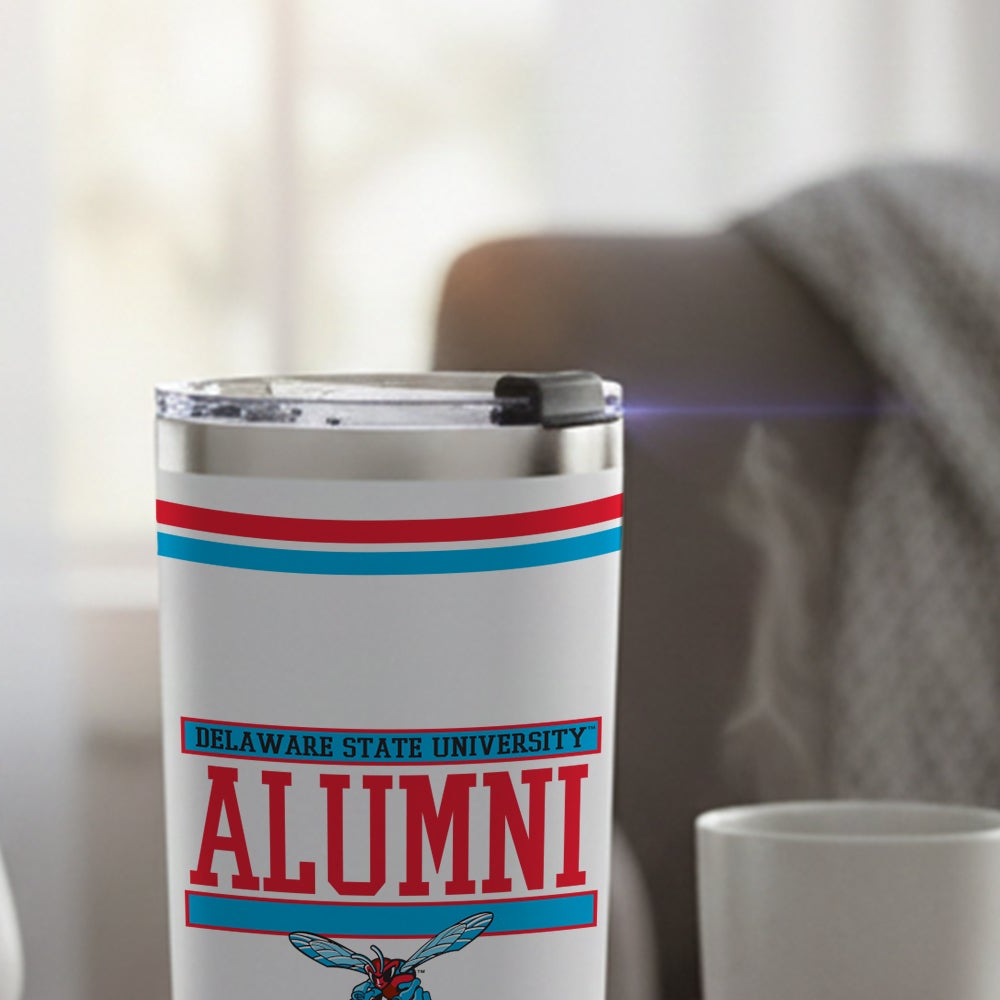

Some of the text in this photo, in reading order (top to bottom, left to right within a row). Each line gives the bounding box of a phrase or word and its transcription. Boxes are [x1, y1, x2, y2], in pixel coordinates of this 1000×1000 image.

[195, 726, 333, 757] DELAWARE
[342, 737, 422, 759] STATE
[189, 764, 589, 897] ALUMNI
